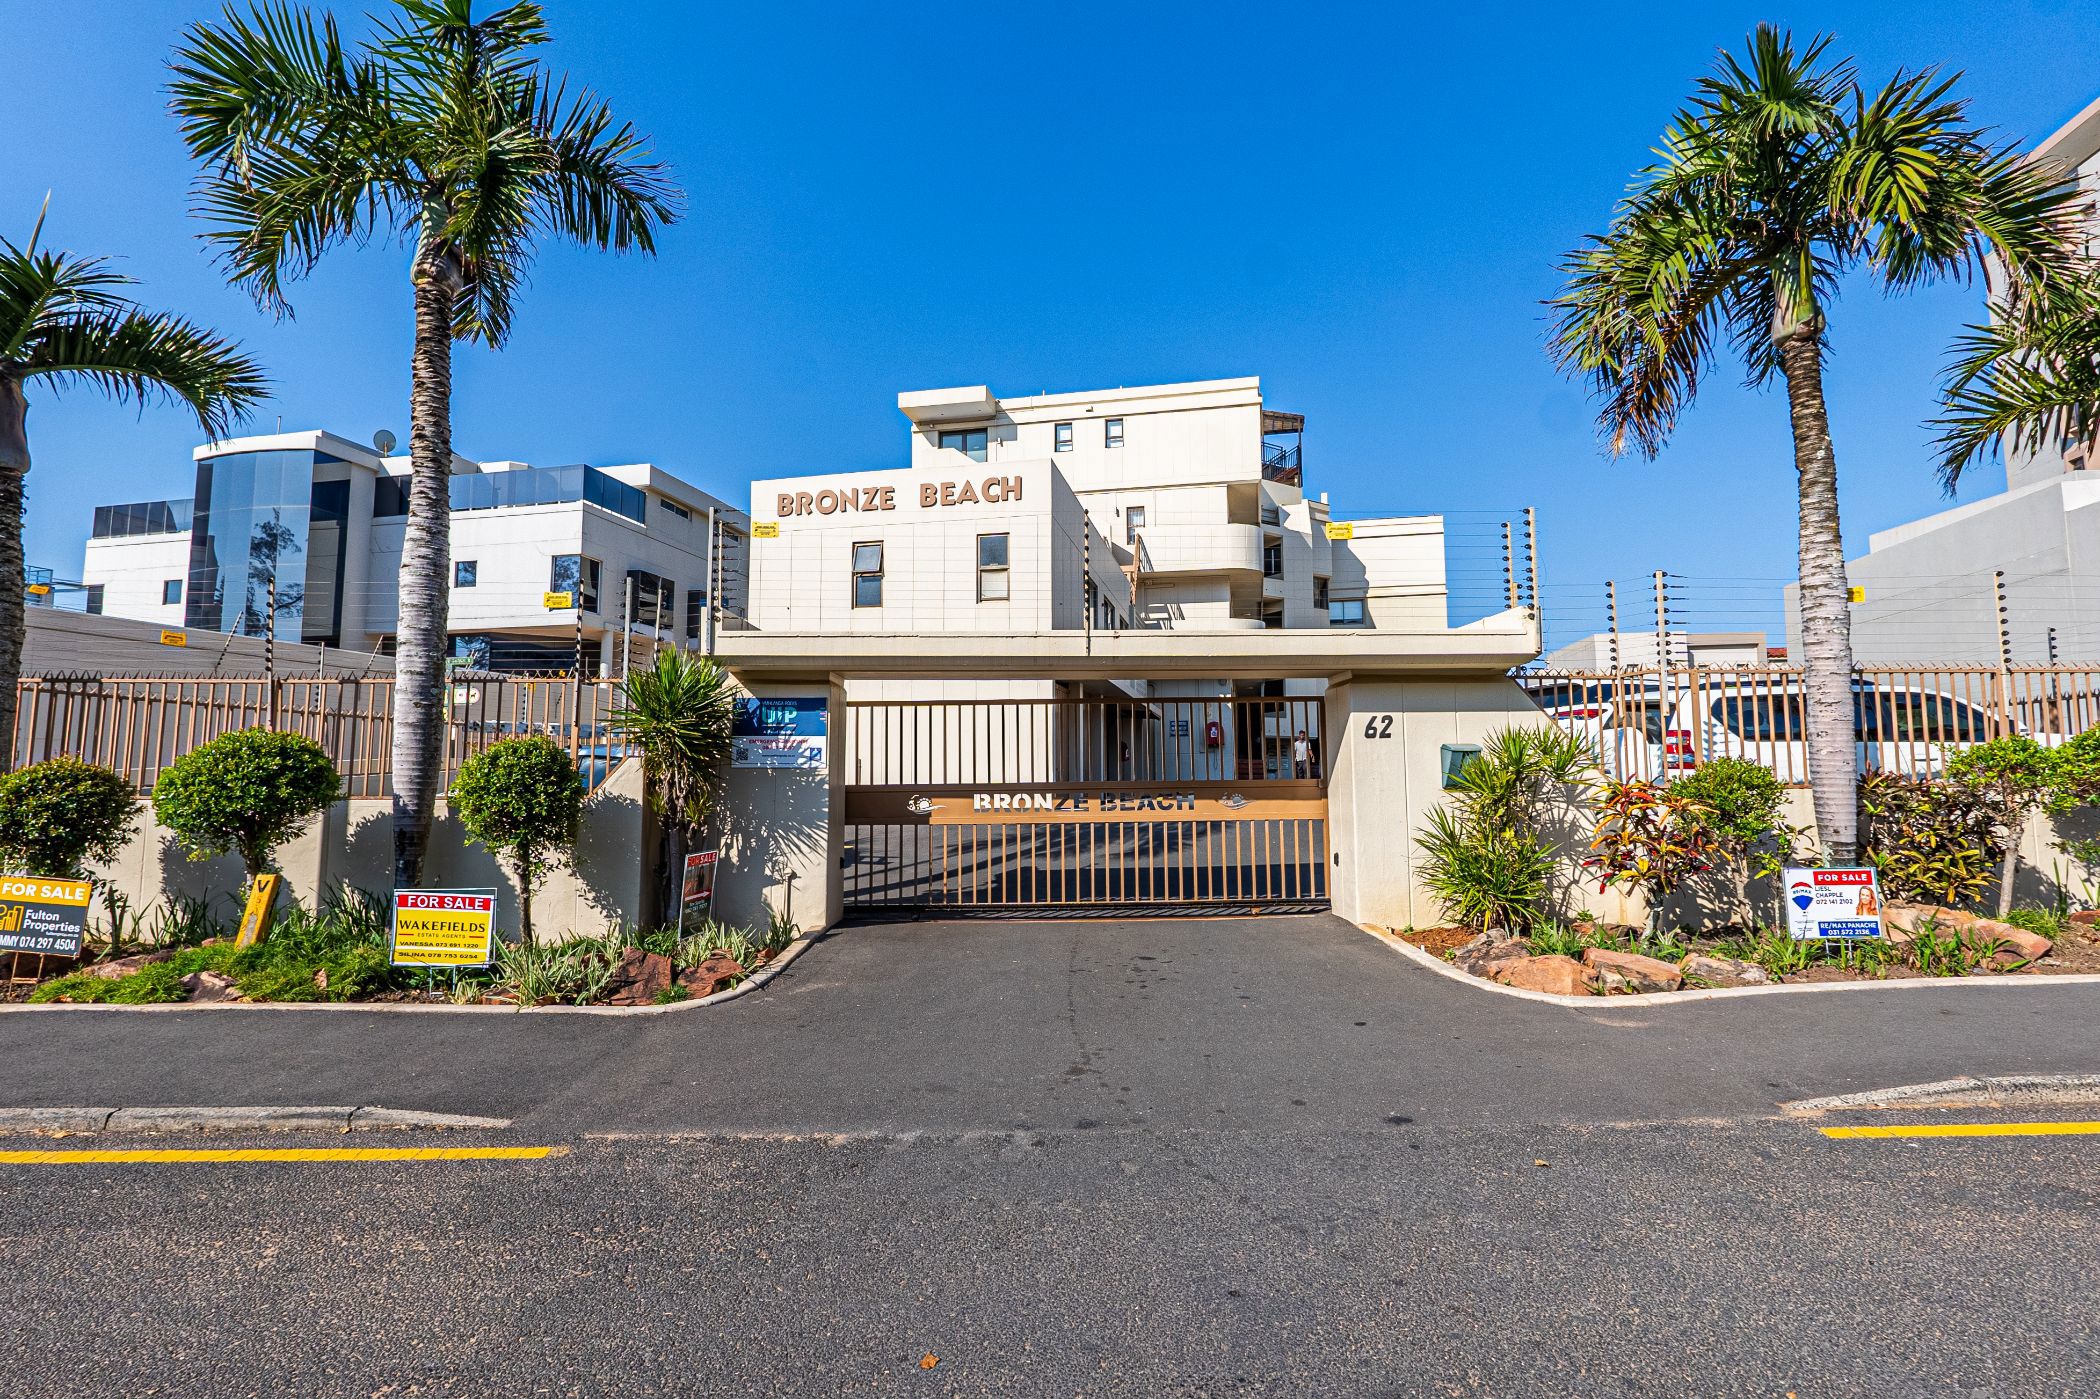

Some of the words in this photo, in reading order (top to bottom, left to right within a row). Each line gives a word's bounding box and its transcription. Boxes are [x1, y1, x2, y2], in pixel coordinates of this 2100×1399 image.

[777, 486, 896, 517] BRONZE
[919, 475, 1023, 508] BEACH
[1364, 715, 1394, 739] 62
[973, 792, 1090, 813] BRONZE
[1100, 792, 1195, 812] BEACH
[700, 852, 716, 864] SALE
[1817, 874, 1838, 882] FOR
[1841, 873, 1868, 881] SALE
[1, 882, 37, 897] FOR
[40, 885, 86, 901] SALE
[407, 896, 439, 907] FOR
[443, 898, 484, 910] SALE
[25, 909, 60, 921] Fulton
[23, 919, 80, 933] Properties
[399, 920, 486, 933] WAKEFIELDS
[19, 936, 36, 949] 074
[36, 937, 54, 949] 297
[53, 939, 77, 951] 4504
